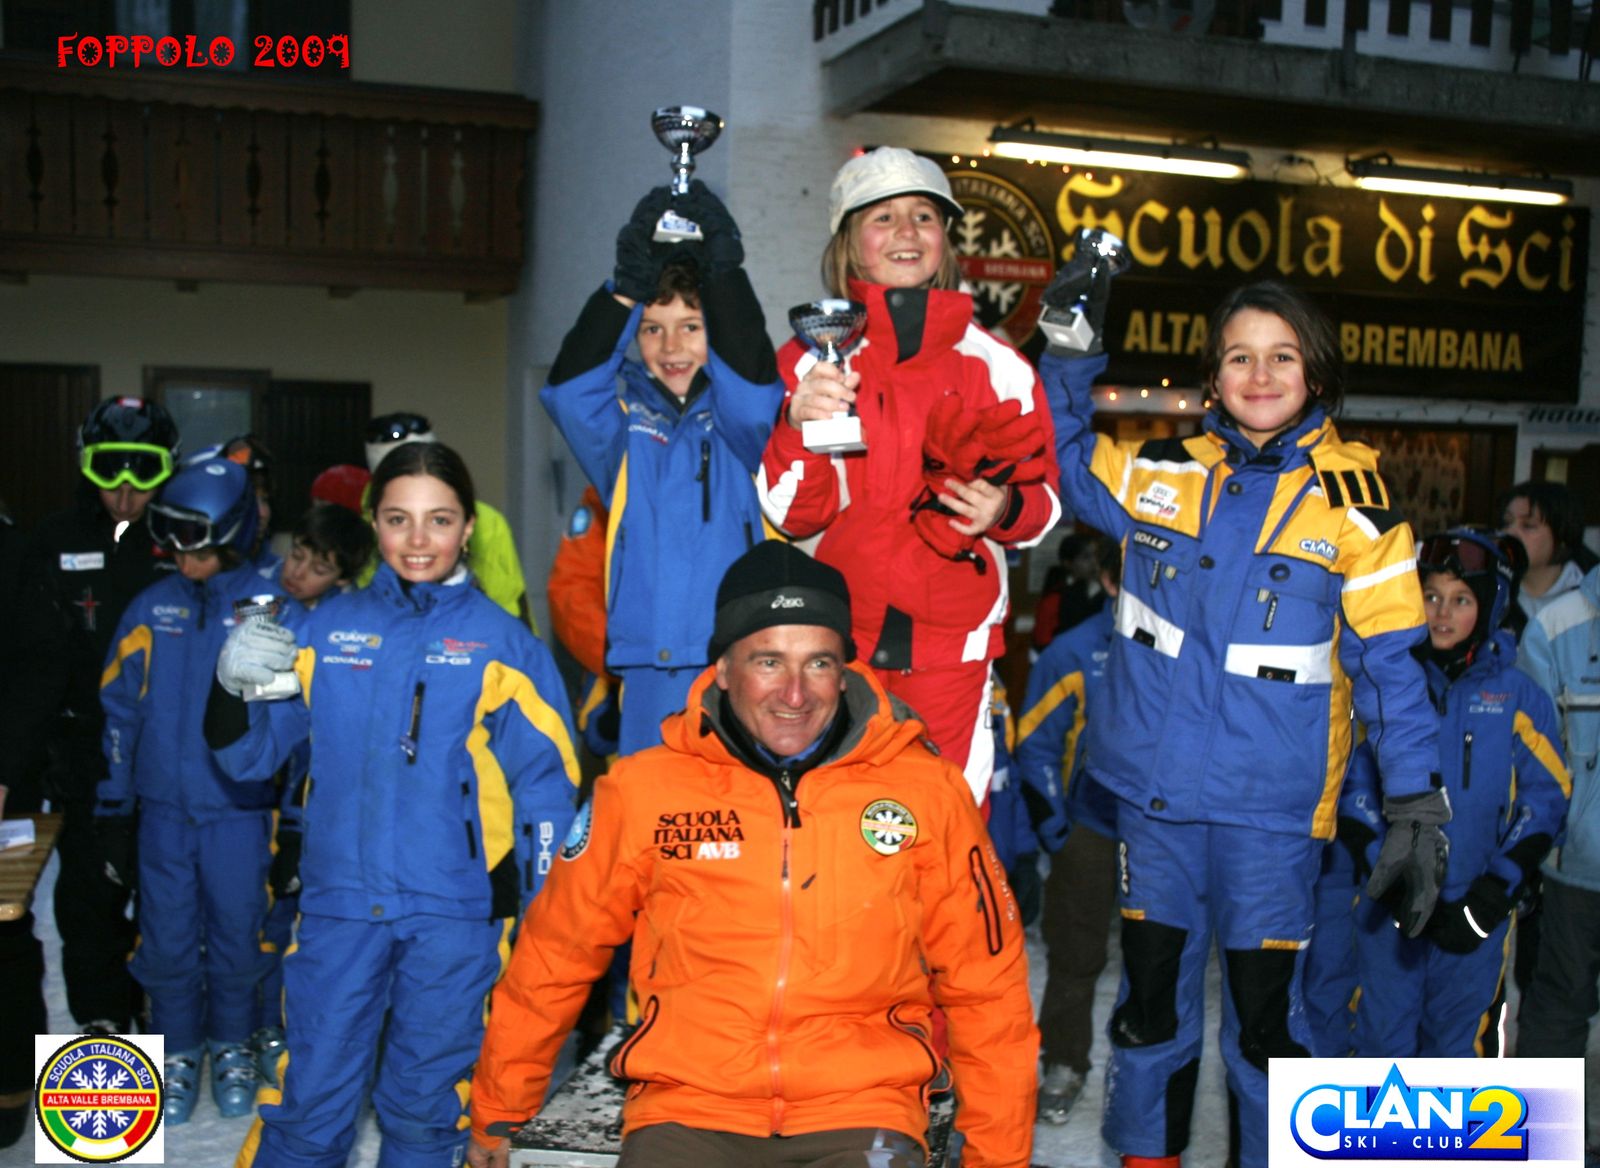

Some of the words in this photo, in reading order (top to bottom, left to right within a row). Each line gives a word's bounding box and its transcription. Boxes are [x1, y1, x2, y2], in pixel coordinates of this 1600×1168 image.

[1057, 173, 1344, 277] Scuola
[1375, 197, 1436, 285] di
[1457, 204, 1576, 292] Sci
[1124, 310, 1209, 355] ALTA
[1341, 321, 1524, 372] BREMBANA
[657, 809, 741, 828] SCUOLA
[653, 826, 745, 845] ITALIANA
[659, 843, 693, 860] SCI
[696, 841, 742, 860] AVB
